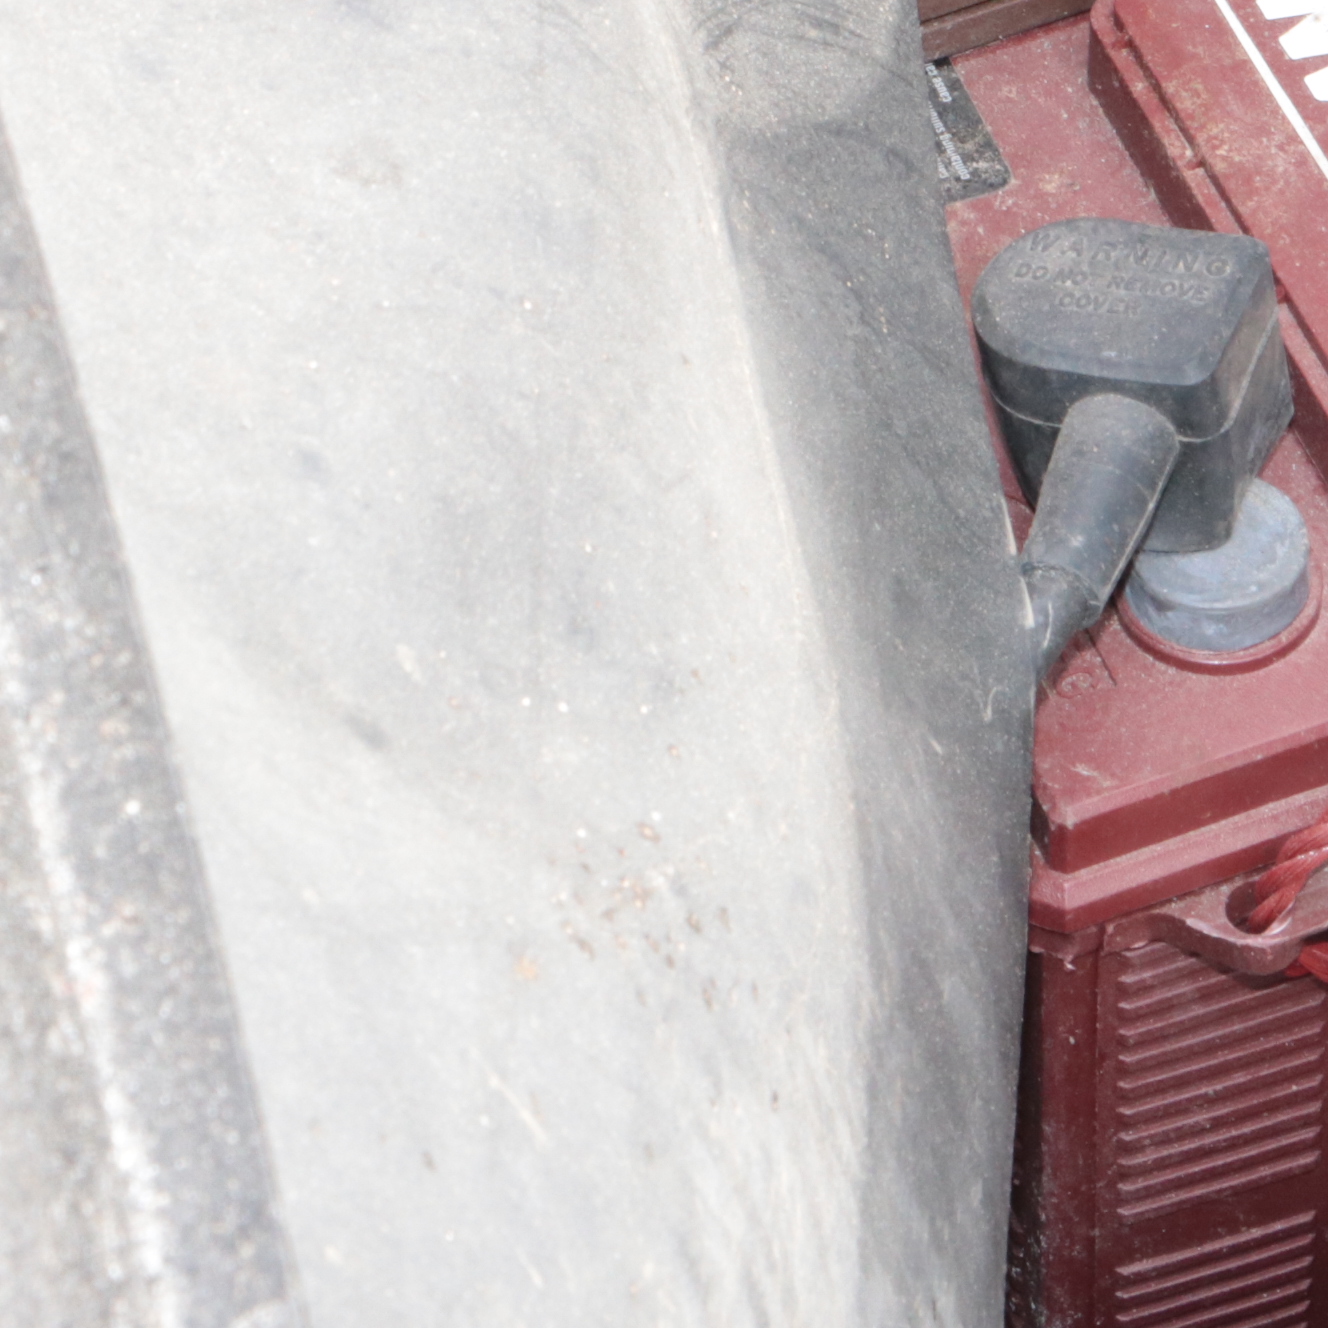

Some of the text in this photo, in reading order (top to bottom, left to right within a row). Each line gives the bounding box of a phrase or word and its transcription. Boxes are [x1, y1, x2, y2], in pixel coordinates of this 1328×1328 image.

[931, 77, 952, 103] cause
[1029, 231, 1231, 278] WARNING
[1014, 262, 1049, 281] DO
[1058, 291, 1143, 317] COVER
